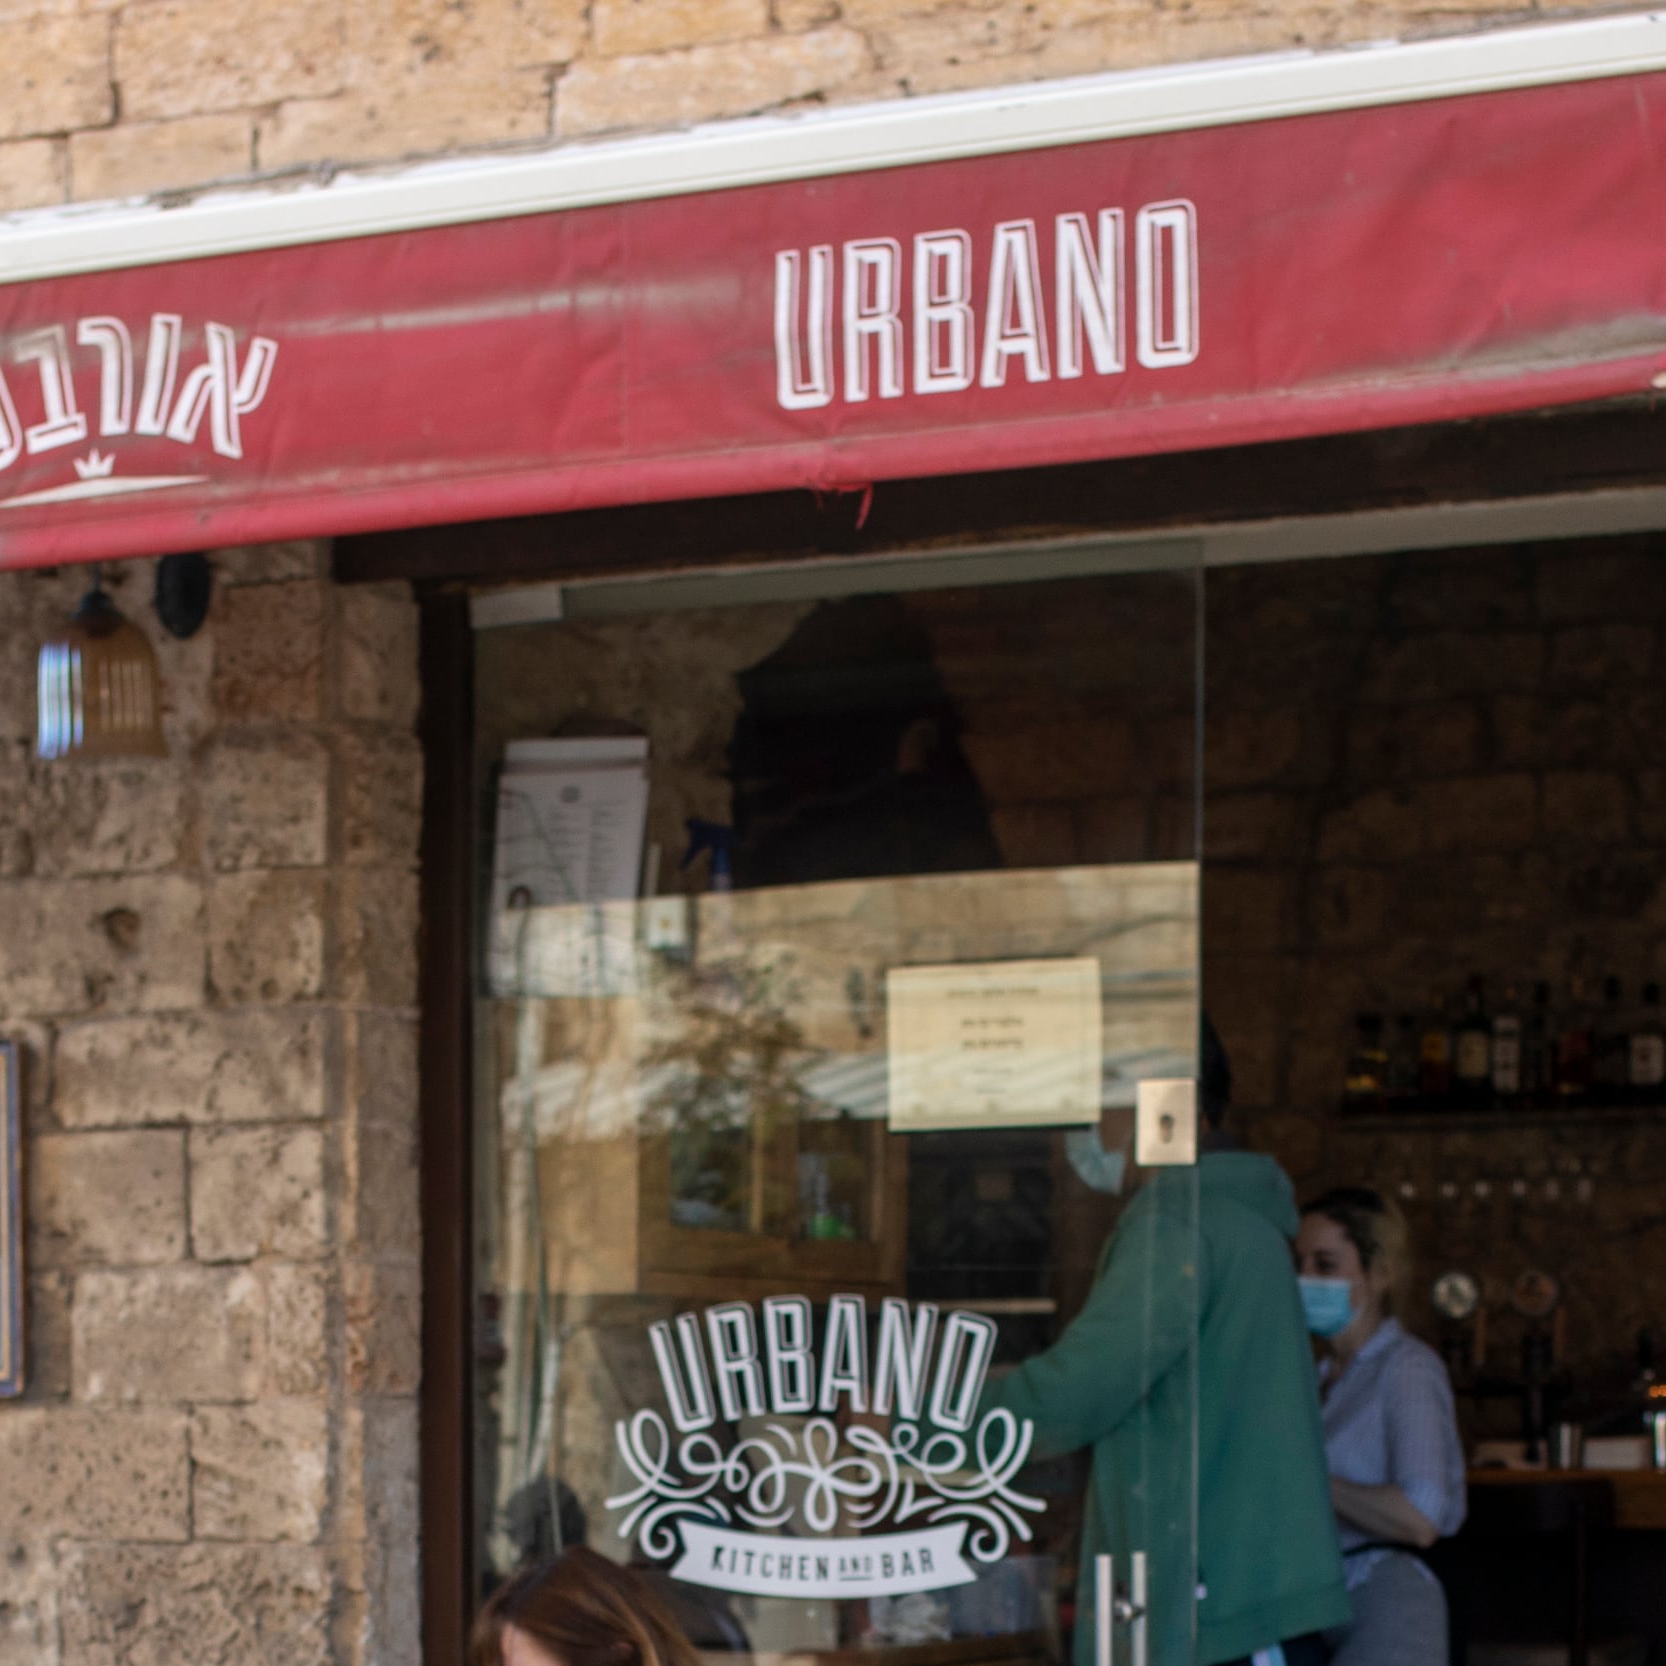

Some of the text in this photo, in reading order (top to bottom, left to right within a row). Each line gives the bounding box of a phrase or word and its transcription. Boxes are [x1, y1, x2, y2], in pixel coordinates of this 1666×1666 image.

[774, 199, 1200, 410] URBANO
[648, 1294, 998, 1432] URBANO
[711, 1546, 935, 1581] KITCHEN AND BAR
